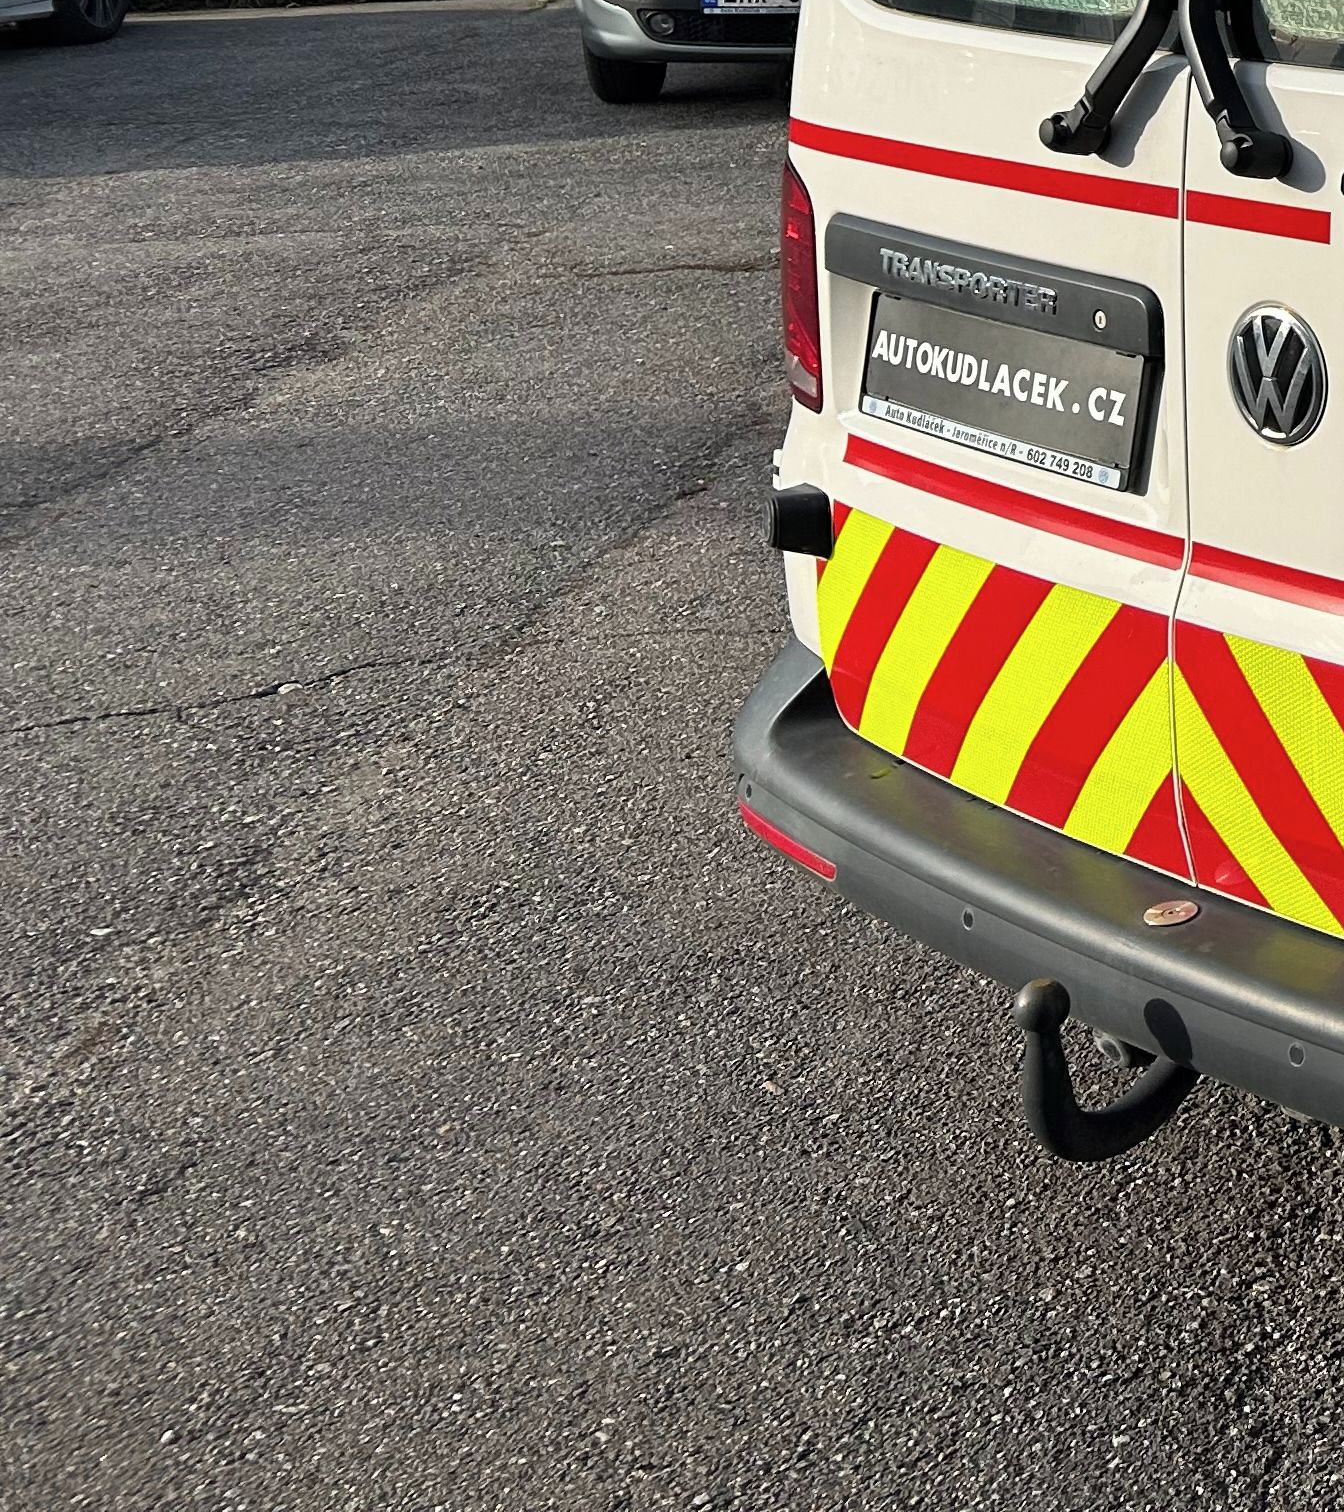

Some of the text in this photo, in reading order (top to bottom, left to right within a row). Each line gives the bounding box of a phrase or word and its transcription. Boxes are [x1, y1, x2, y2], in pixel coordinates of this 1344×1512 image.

[879, 247, 1058, 316] TRANSPORTER
[884, 404, 905, 422] Auto
[1026, 447, 1047, 466] 602
[1049, 454, 1071, 472] 749
[1071, 461, 1094, 479] 208
